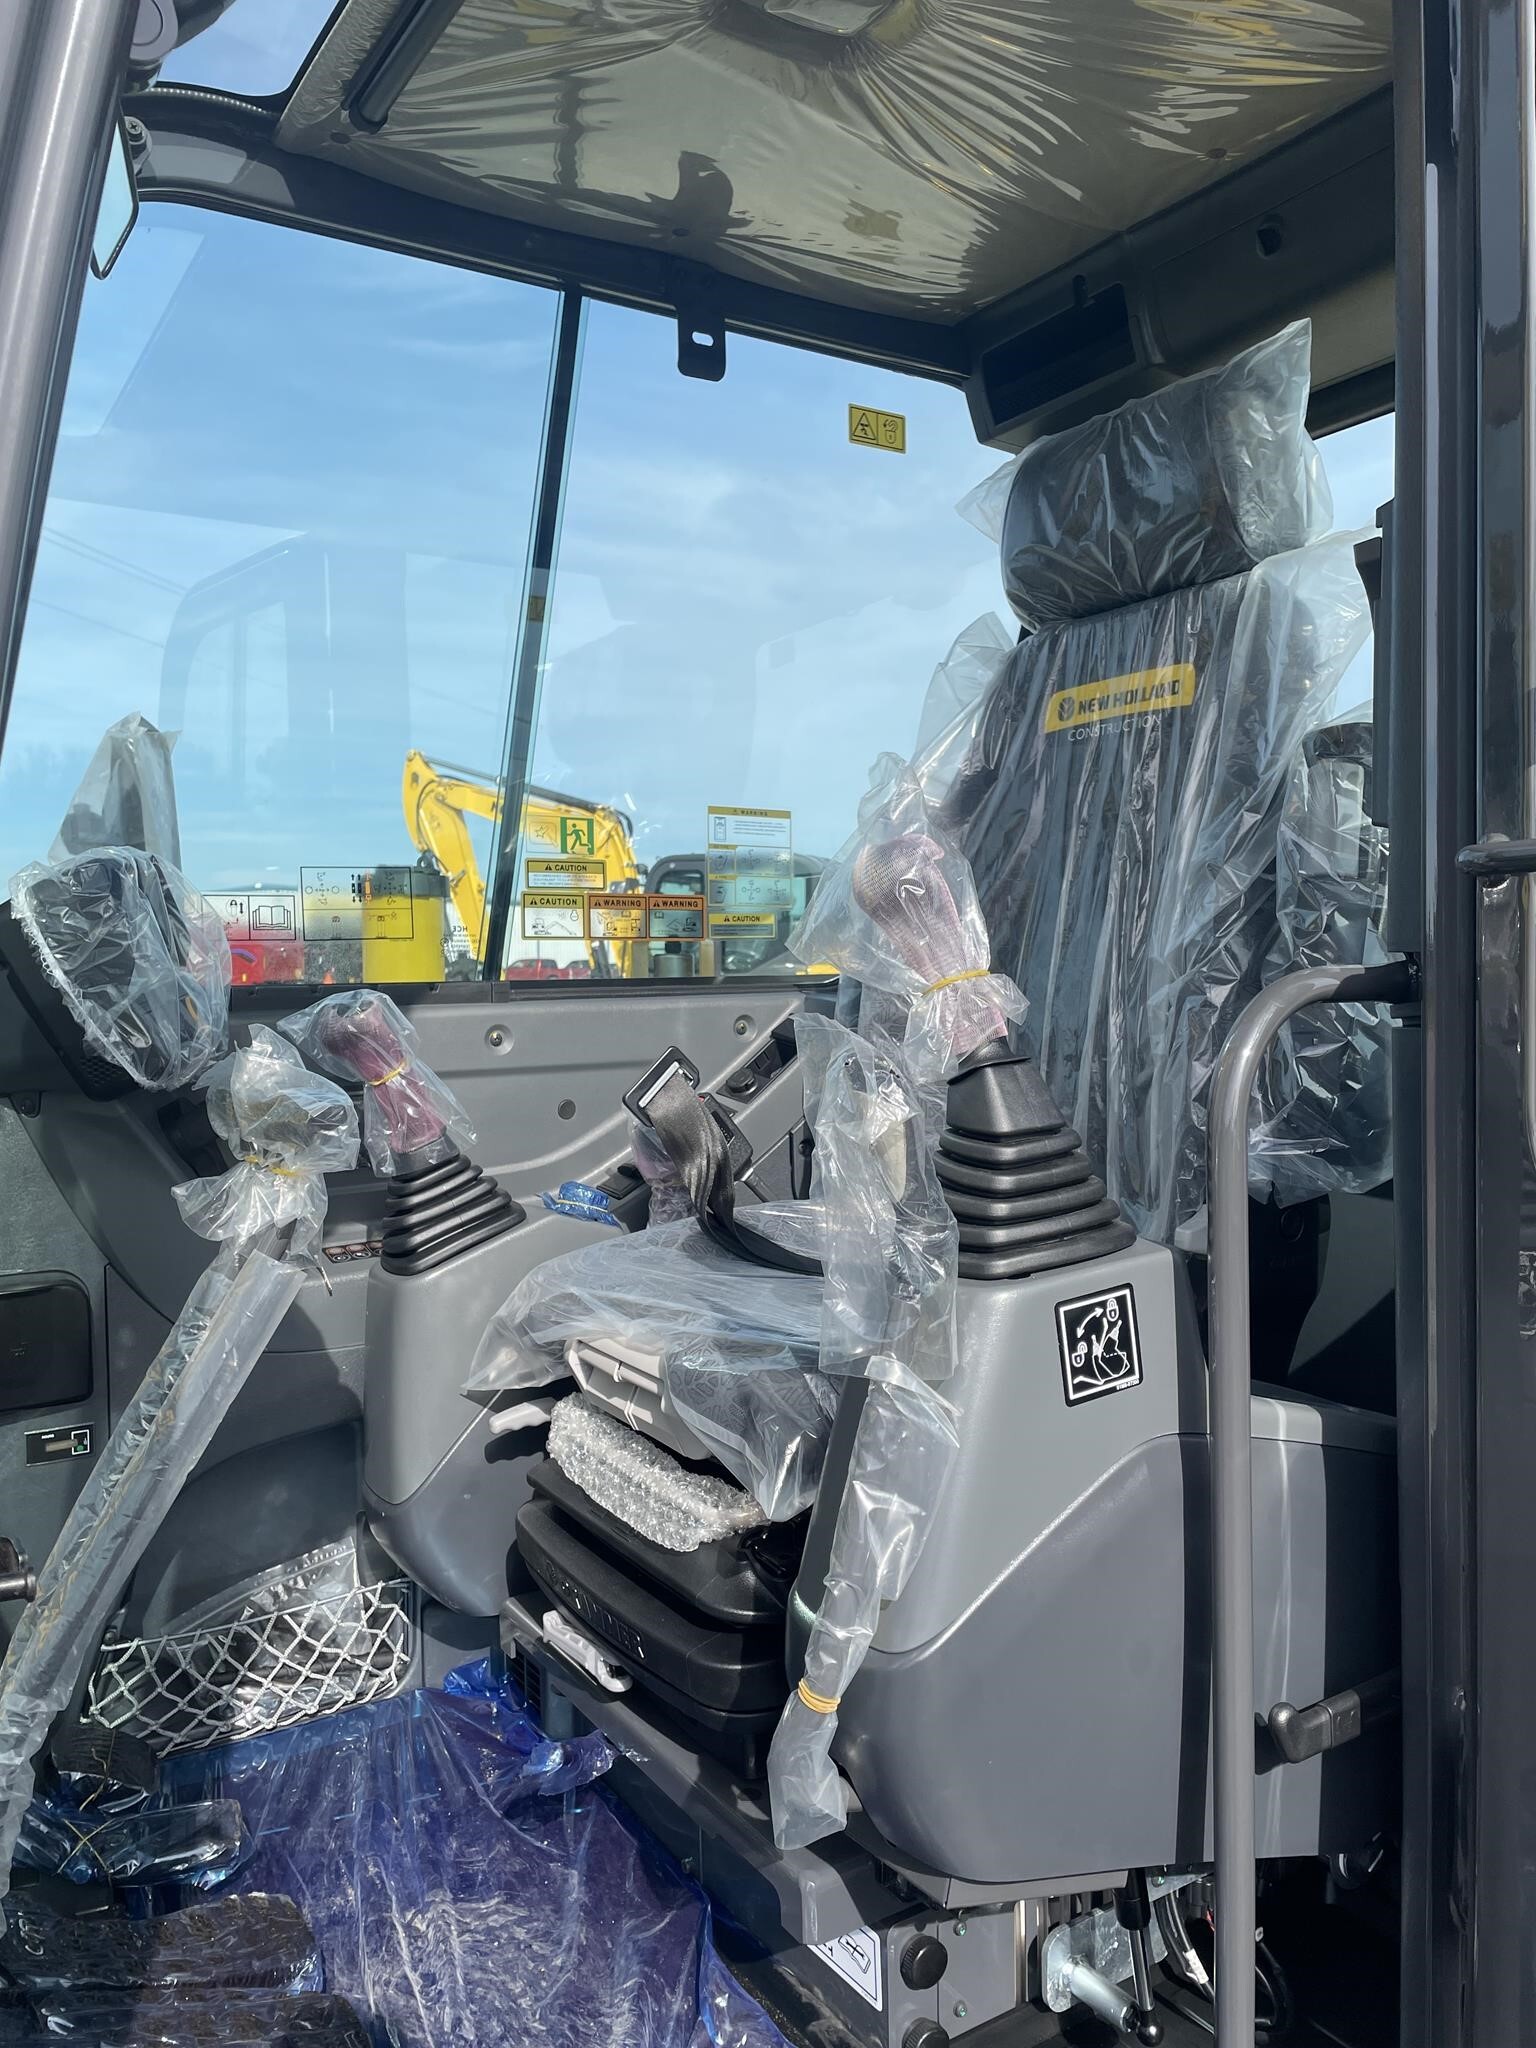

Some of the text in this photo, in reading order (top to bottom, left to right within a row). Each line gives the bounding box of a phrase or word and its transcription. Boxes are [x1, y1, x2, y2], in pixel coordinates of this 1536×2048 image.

[1078, 679, 1180, 715] NEW HOLLAND
[1067, 715, 1161, 742] CONSTRUCTION
[554, 864, 587, 872] CAUTION
[539, 898, 577, 906] CAUTION
[603, 899, 641, 907] WARNING
[662, 900, 698, 908] WARNING
